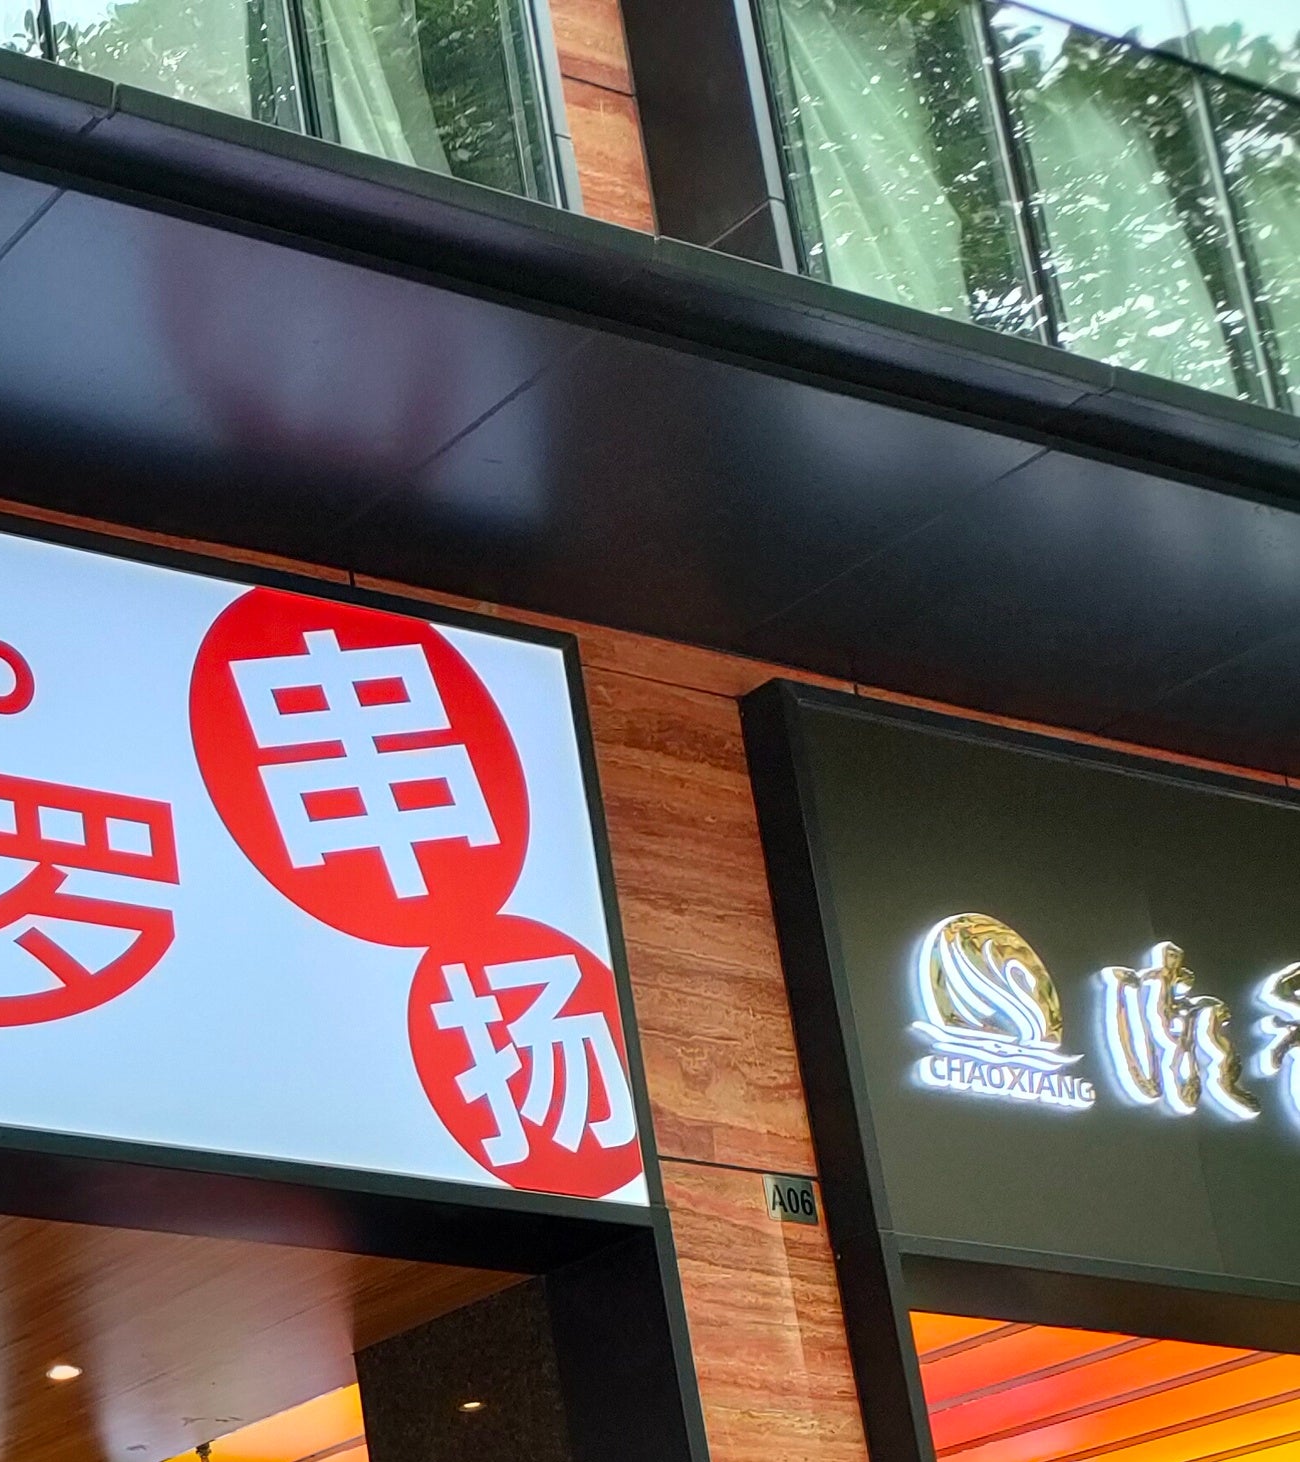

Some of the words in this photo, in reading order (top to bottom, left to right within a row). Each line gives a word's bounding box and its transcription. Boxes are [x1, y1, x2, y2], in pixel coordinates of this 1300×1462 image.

[229, 629, 500, 899] 串
[430, 953, 637, 1167] 扬
[922, 1054, 1096, 1108] CHAOXIANG
[1100, 941, 1300, 1140] 潮
[772, 1184, 814, 1216] A06
